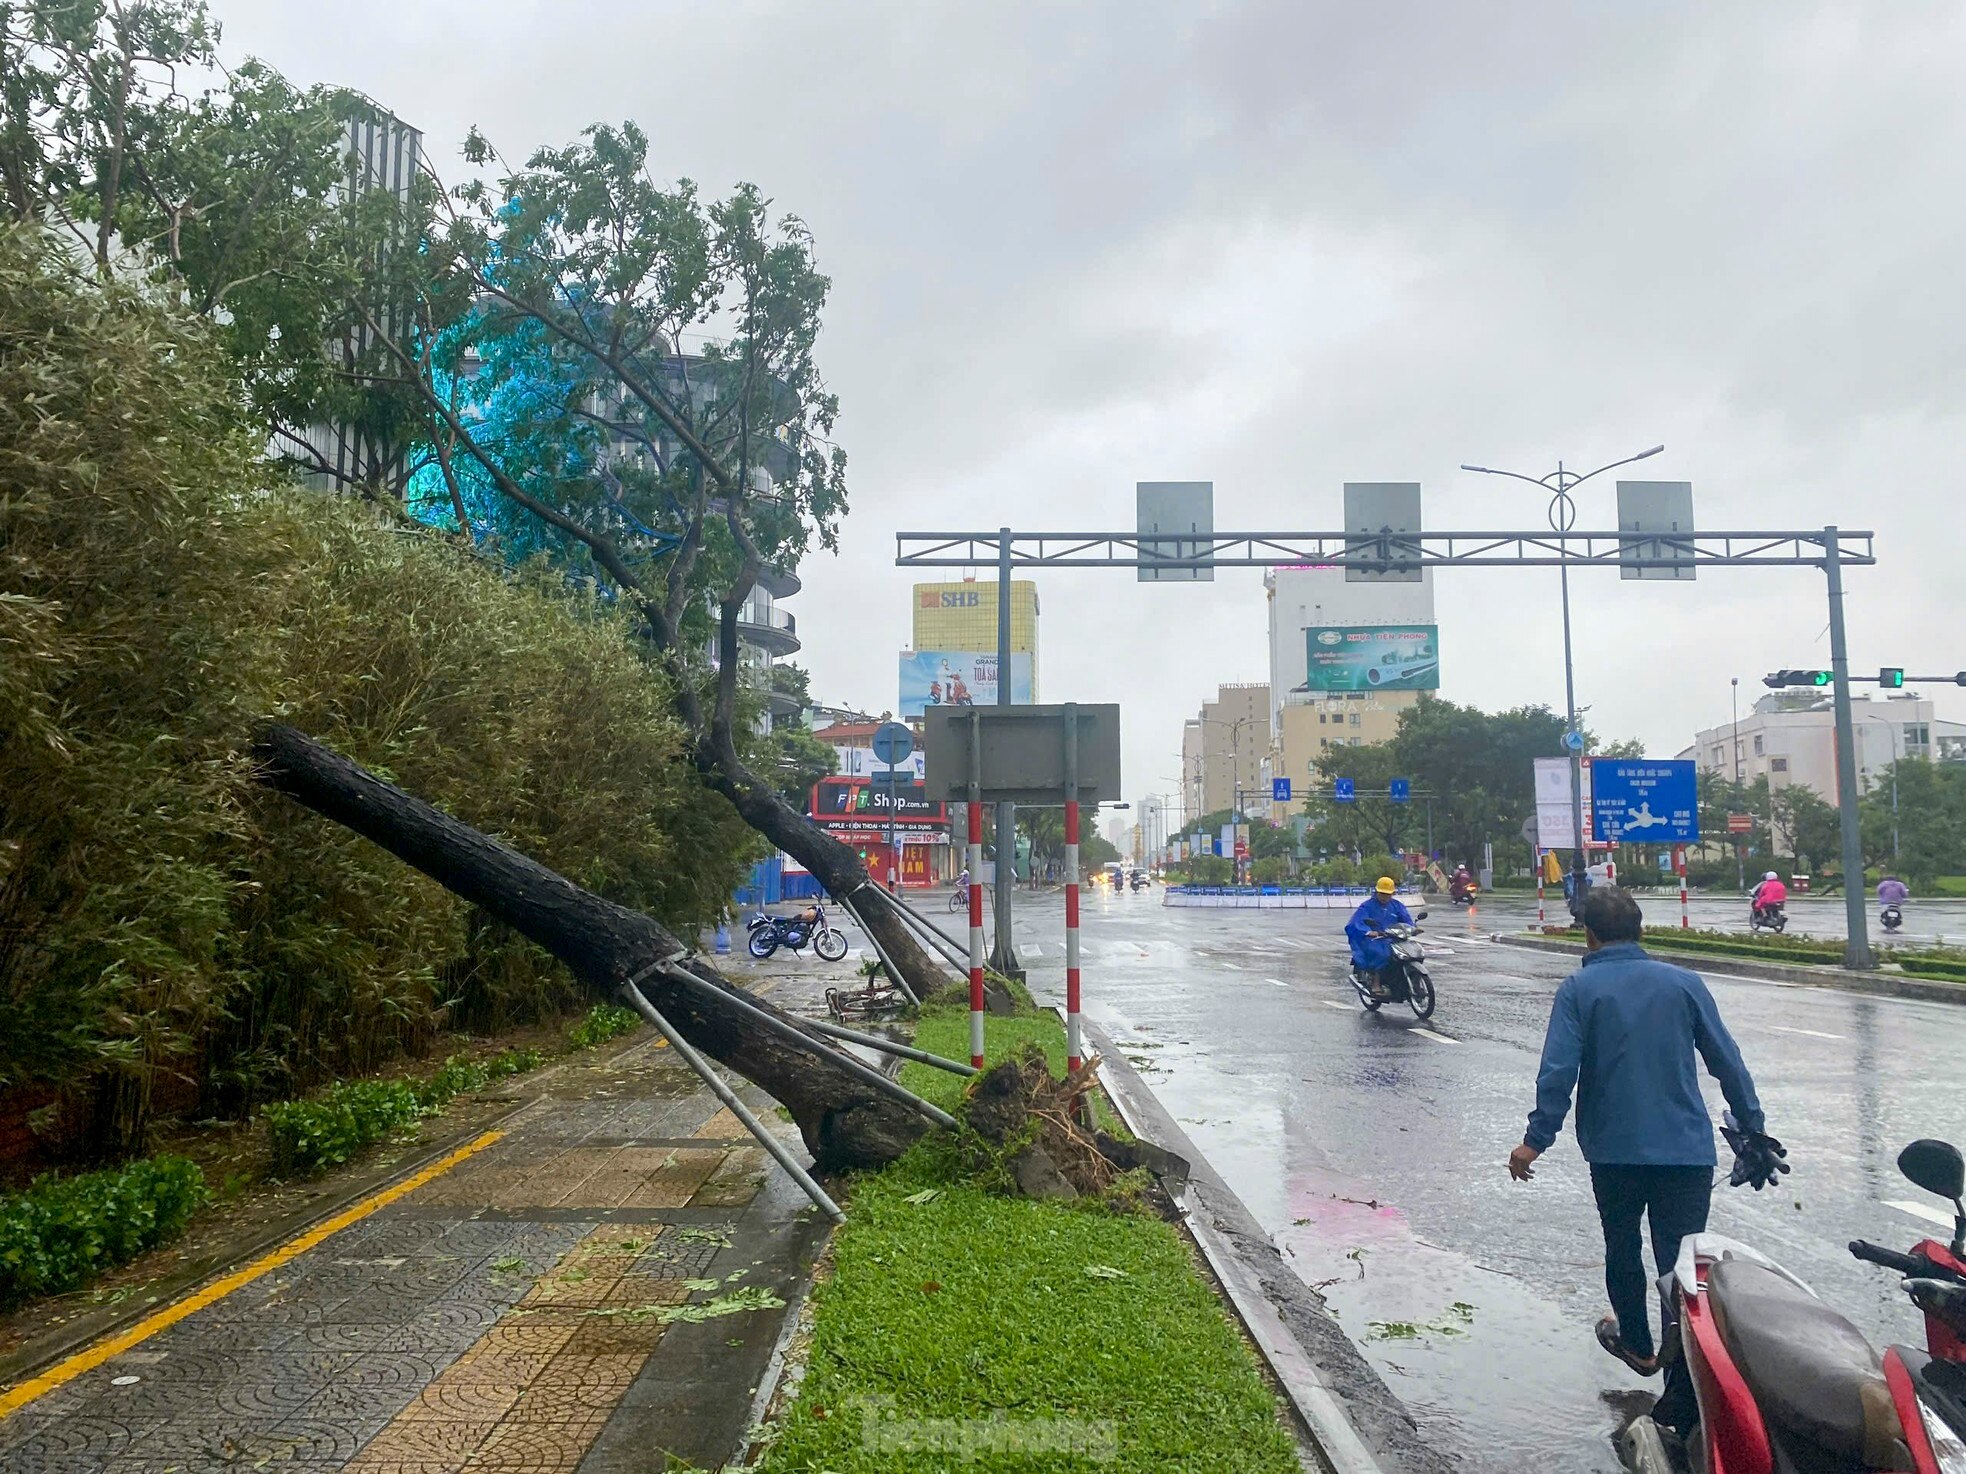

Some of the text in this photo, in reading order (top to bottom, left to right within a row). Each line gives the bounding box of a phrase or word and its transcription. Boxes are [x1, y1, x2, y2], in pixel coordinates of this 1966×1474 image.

[941, 591, 979, 607] SHB
[1398, 632, 1428, 640] PHONG
[923, 834, 940, 842] 10%
